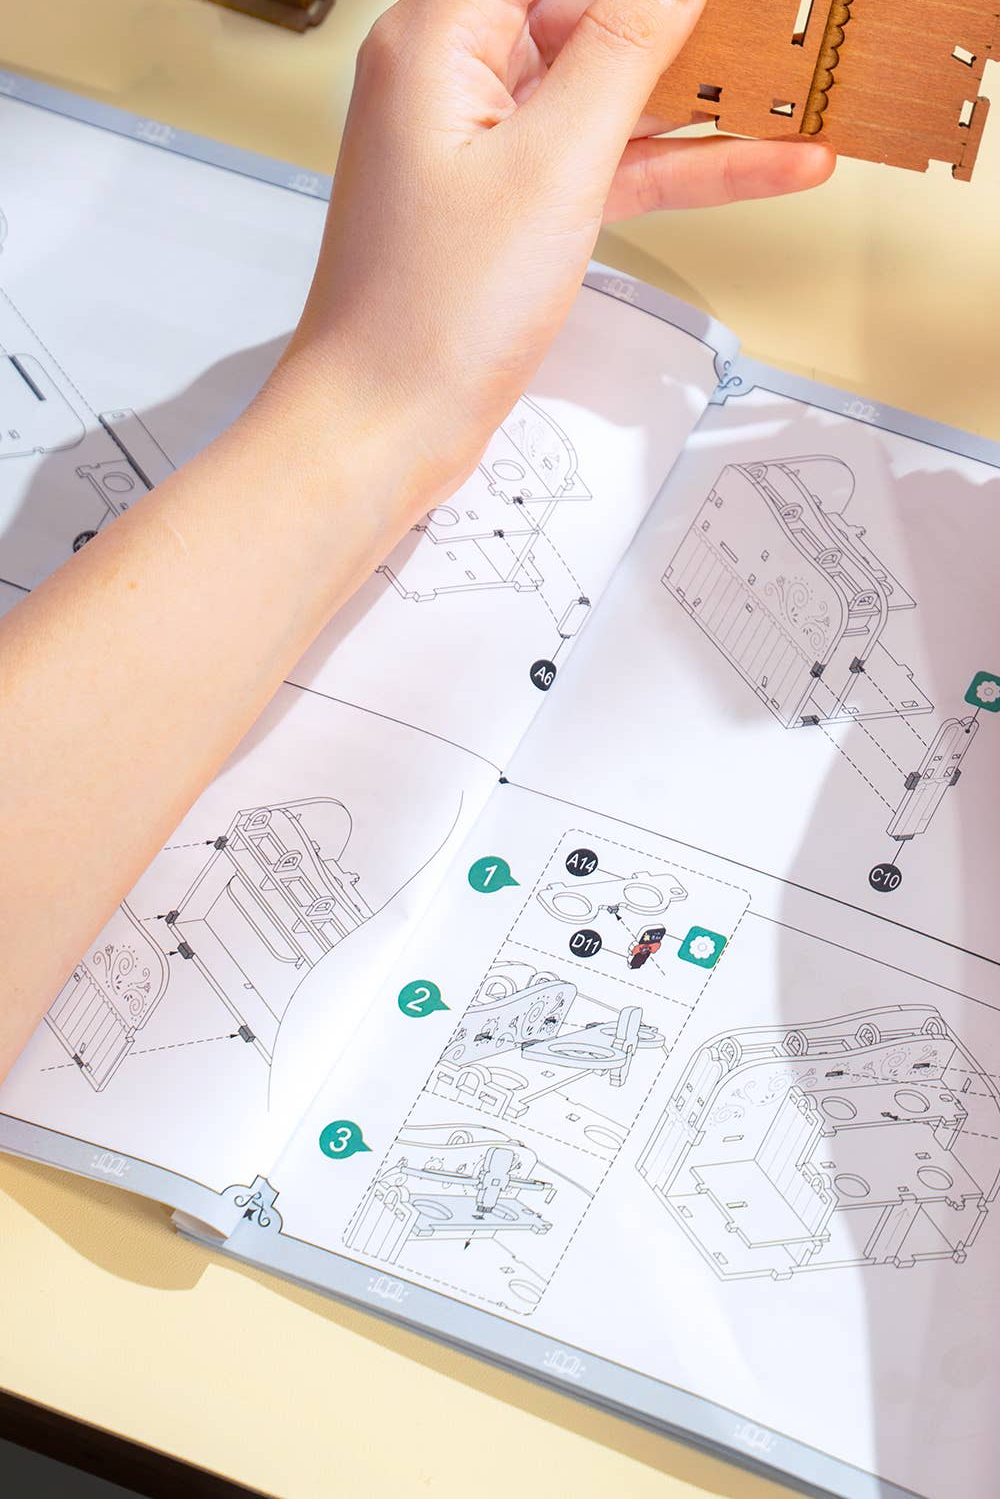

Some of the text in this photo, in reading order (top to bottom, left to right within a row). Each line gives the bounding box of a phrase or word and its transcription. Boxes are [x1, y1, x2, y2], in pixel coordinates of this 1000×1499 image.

[534, 666, 554, 685] A6
[566, 853, 596, 873] A14
[483, 864, 498, 887] 1
[871, 867, 900, 888] C10
[571, 933, 600, 954] D11
[406, 987, 430, 1012] 2
[329, 1127, 352, 1152] 3
